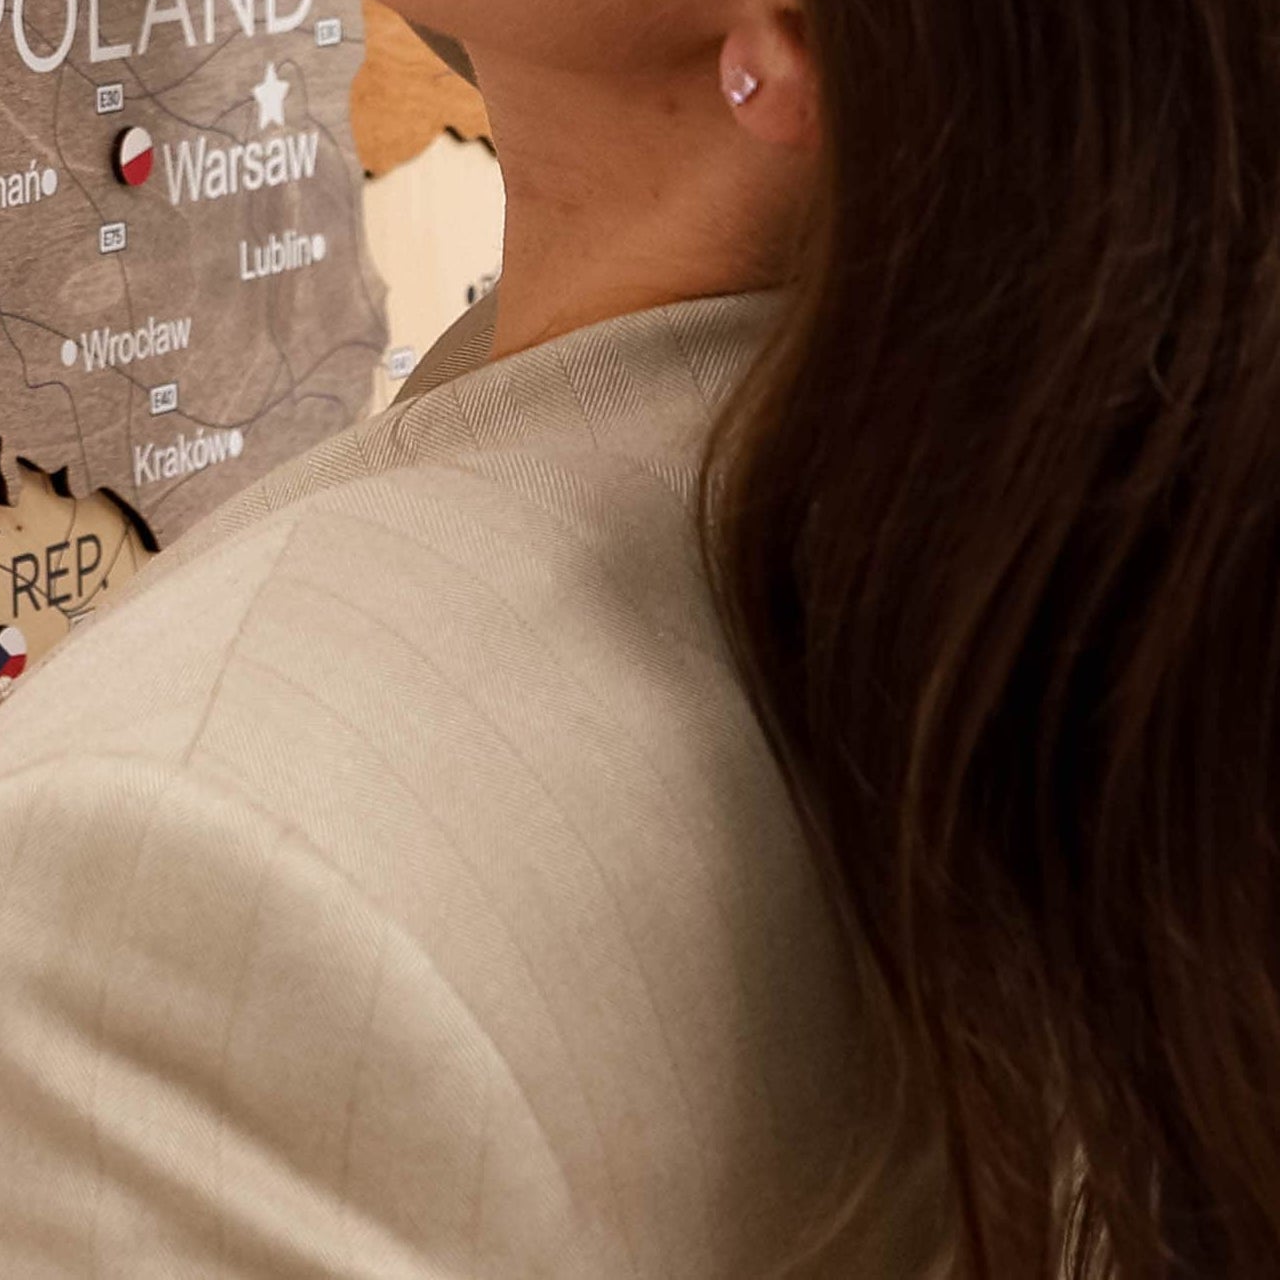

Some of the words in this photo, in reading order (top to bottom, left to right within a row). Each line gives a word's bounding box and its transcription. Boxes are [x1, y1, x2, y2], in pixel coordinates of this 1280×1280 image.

[163, 131, 320, 207] Warsaw
[240, 232, 312, 282] Lublin
[134, 427, 230, 486] Kraków
